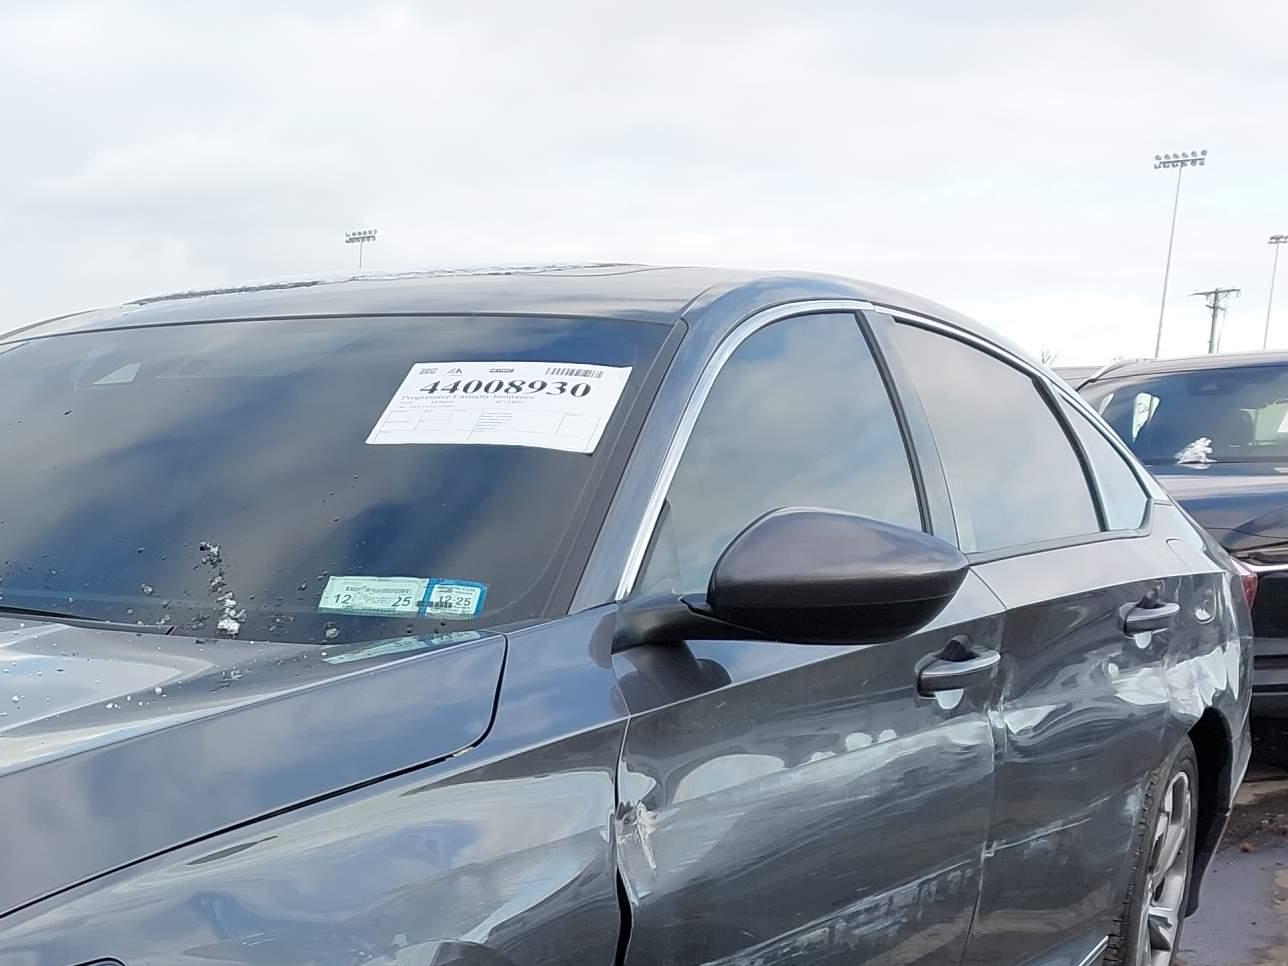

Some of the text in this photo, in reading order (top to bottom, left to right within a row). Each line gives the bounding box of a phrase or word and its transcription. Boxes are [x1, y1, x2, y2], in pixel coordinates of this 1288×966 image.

[420, 380, 591, 397] 44008930
[334, 593, 352, 604] 12
[392, 596, 412, 607] 25
